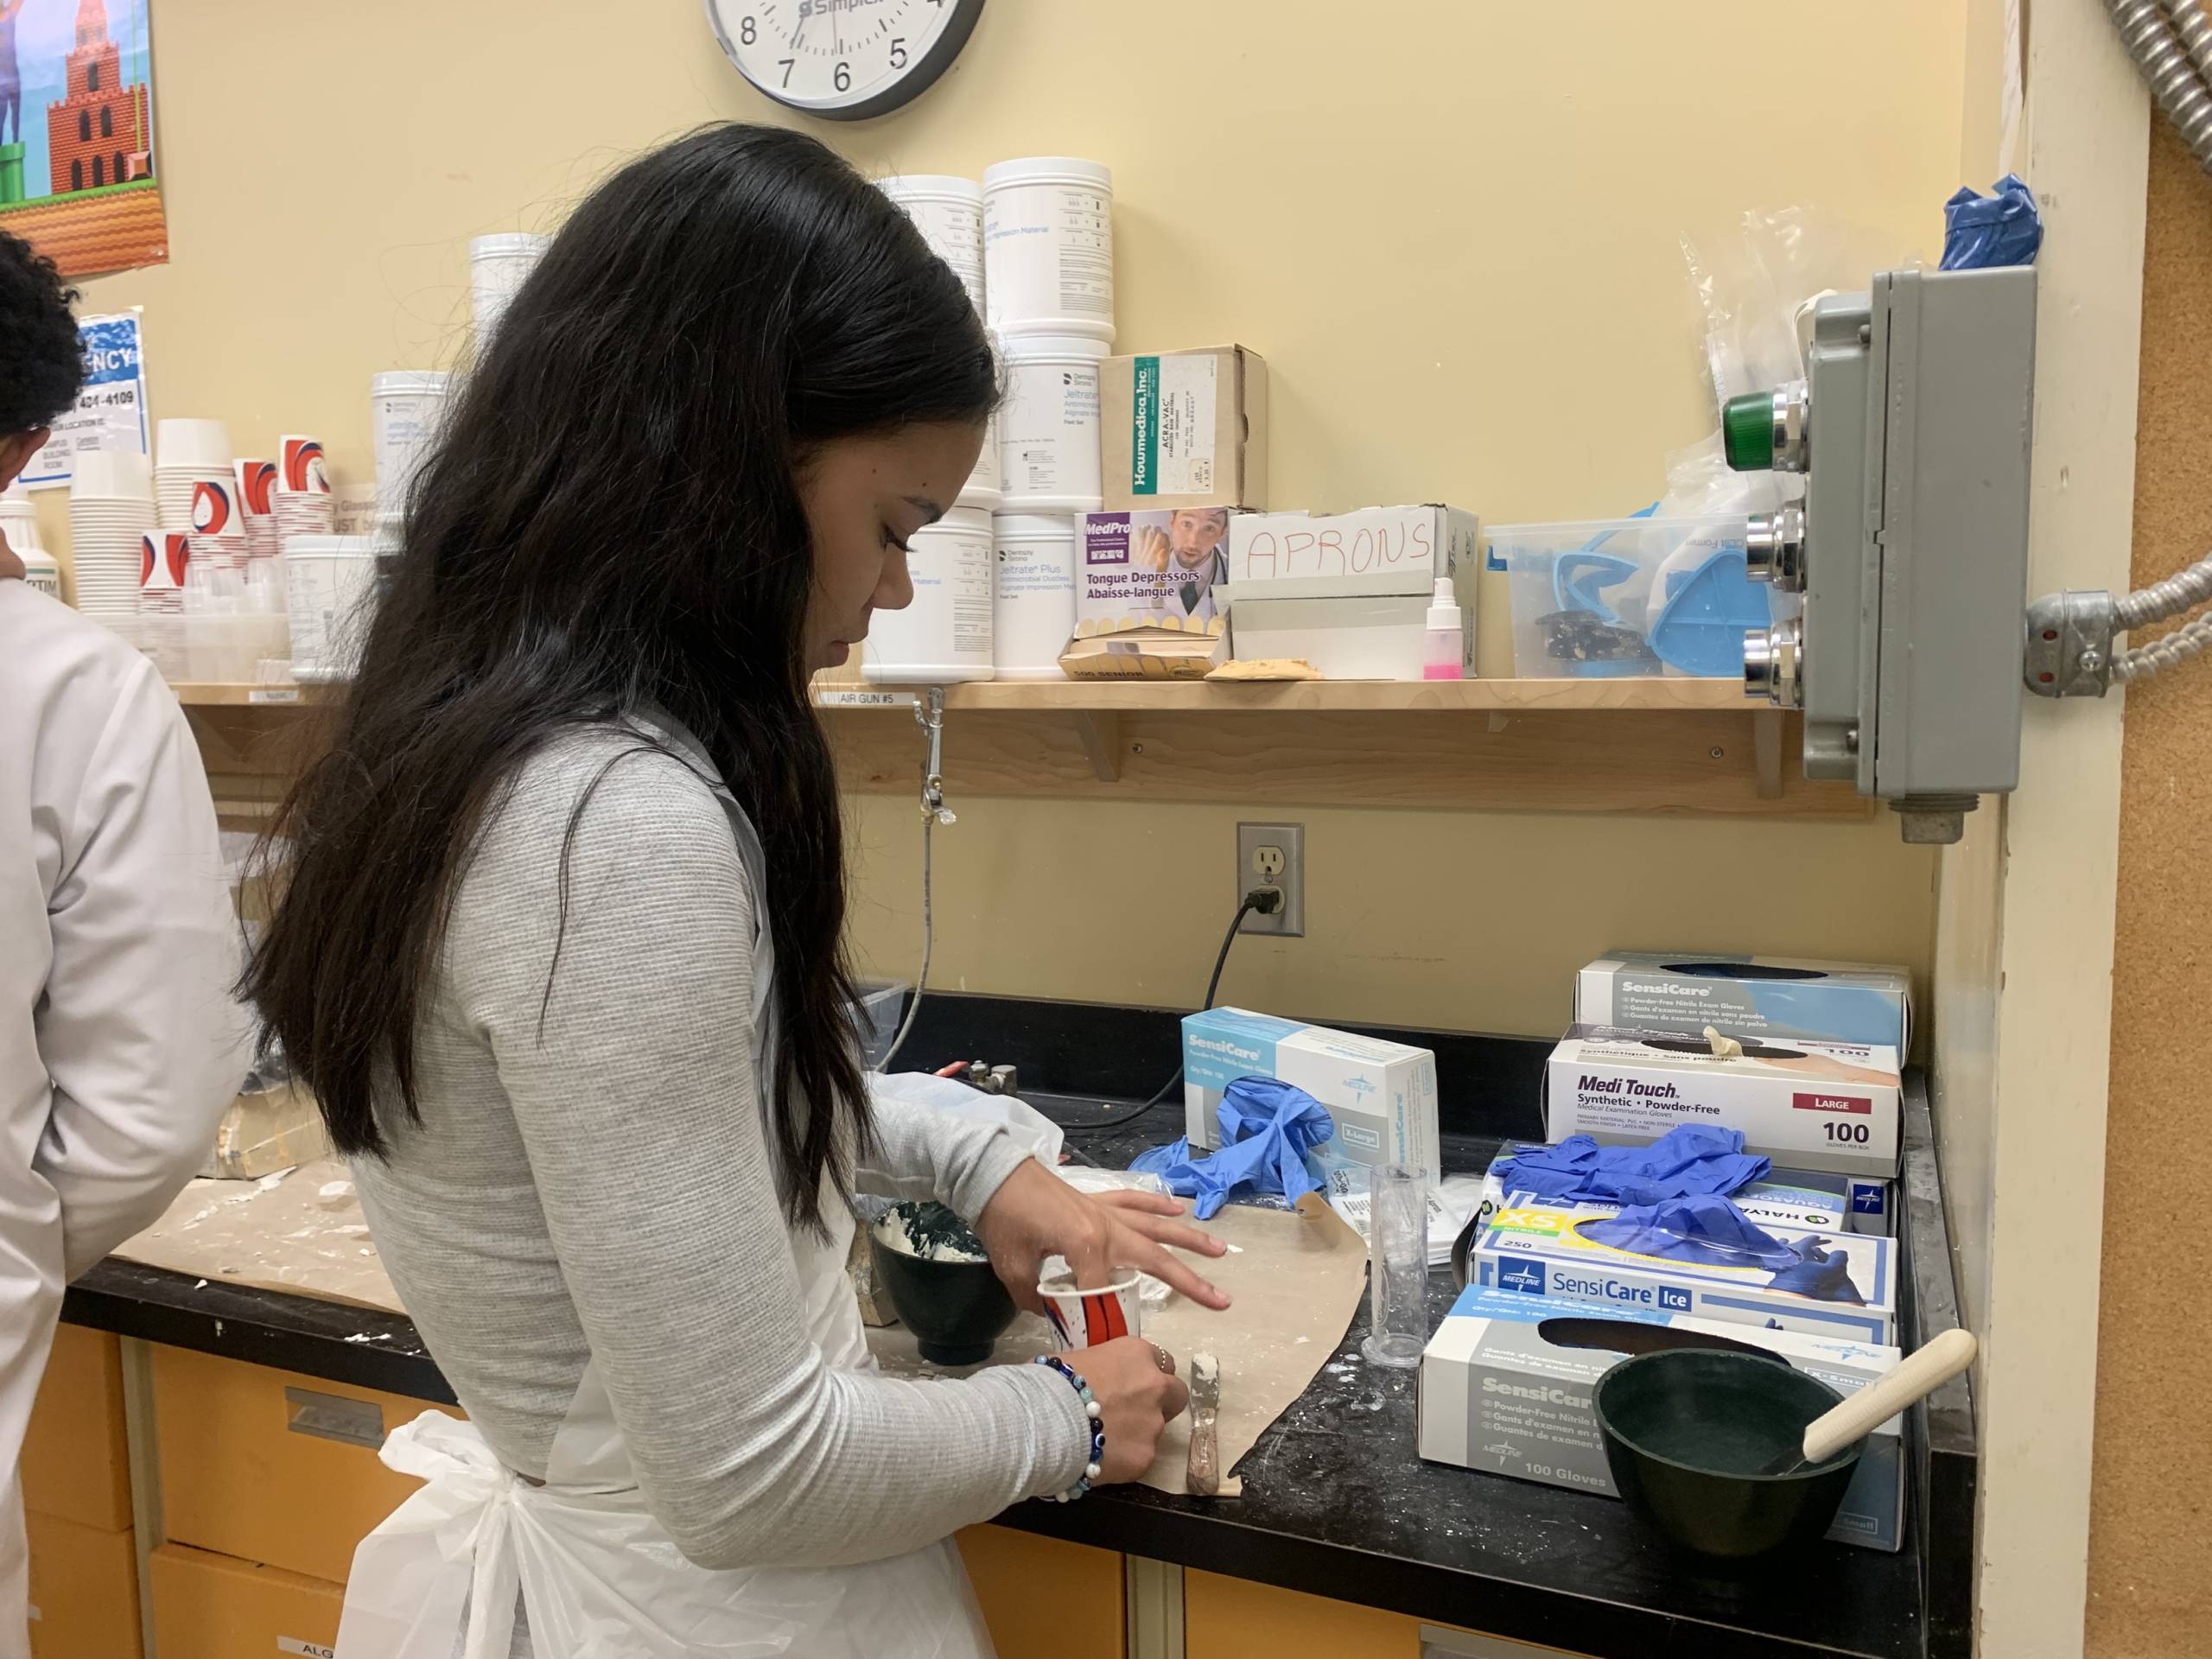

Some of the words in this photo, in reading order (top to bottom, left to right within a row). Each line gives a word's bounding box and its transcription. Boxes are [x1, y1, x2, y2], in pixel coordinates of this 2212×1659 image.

[741, 16, 757, 45] 8
[889, 38, 907, 69] 5
[778, 59, 796, 88] 7
[834, 62, 851, 92] 6
[1084, 522, 1131, 536] MedPro
[1247, 521, 1430, 579] APRONS
[1040, 563, 1062, 574] Plus
[1086, 574, 1128, 586] Tongue
[1131, 571, 1200, 583] Depressors
[1086, 587, 1175, 600] Abaisse-langue
[841, 693, 856, 702] AIR
[859, 694, 880, 703] GUN
[883, 694, 894, 703] #5
[1622, 981, 1711, 997] SensiCare
[1699, 1008, 1720, 1017] nitrile
[1739, 1013, 1765, 1021] poudre
[1189, 1033, 1259, 1060] SensiCare
[1578, 1075, 1624, 1094] Medi
[1626, 1078, 1676, 1098] Touch
[1577, 1103, 1604, 1112] Medical
[1605, 1106, 1648, 1116] Examination
[1649, 1109, 1673, 1118] Gloves
[1578, 1093, 1632, 1108] Synthetic
[1645, 1099, 1721, 1115] Powder-Free
[1815, 1097, 1850, 1109] LARGE
[1345, 1128, 1377, 1144] X-Large
[1823, 1122, 1870, 1143] 100
[1744, 1194, 1833, 1210] AQUASOF
[1502, 1211, 1556, 1227] XS
[1503, 1226, 1543, 1235] NITRILE
[1503, 1240, 1532, 1249] 250
[1502, 1274, 1541, 1287] MEDLINE
[1553, 1272, 1652, 1304] SensiCare
[1663, 1290, 1687, 1306] Ice
[1481, 1351, 1527, 1365] Guantes
[1545, 1364, 1591, 1376] examen
[1484, 1347, 1516, 1357] Gants
[1517, 1352, 1573, 1367] d'examen
[1481, 1376, 1593, 1410] SensiCar
[1492, 1400, 1556, 1420] Powder-Free
[1559, 1411, 1591, 1427] Nitrile
[1492, 1412, 1522, 1426] Gants
[1524, 1418, 1574, 1435] d'examen
[1577, 1429, 1590, 1438] en
[1492, 1422, 1535, 1439] Guantes
[1536, 1431, 1549, 1440] de
[1552, 1436, 1593, 1450] examen
[1525, 1462, 1552, 1477] 100
[1556, 1468, 1606, 1487] Gloves
[302, 1644, 334, 1659] ALG
